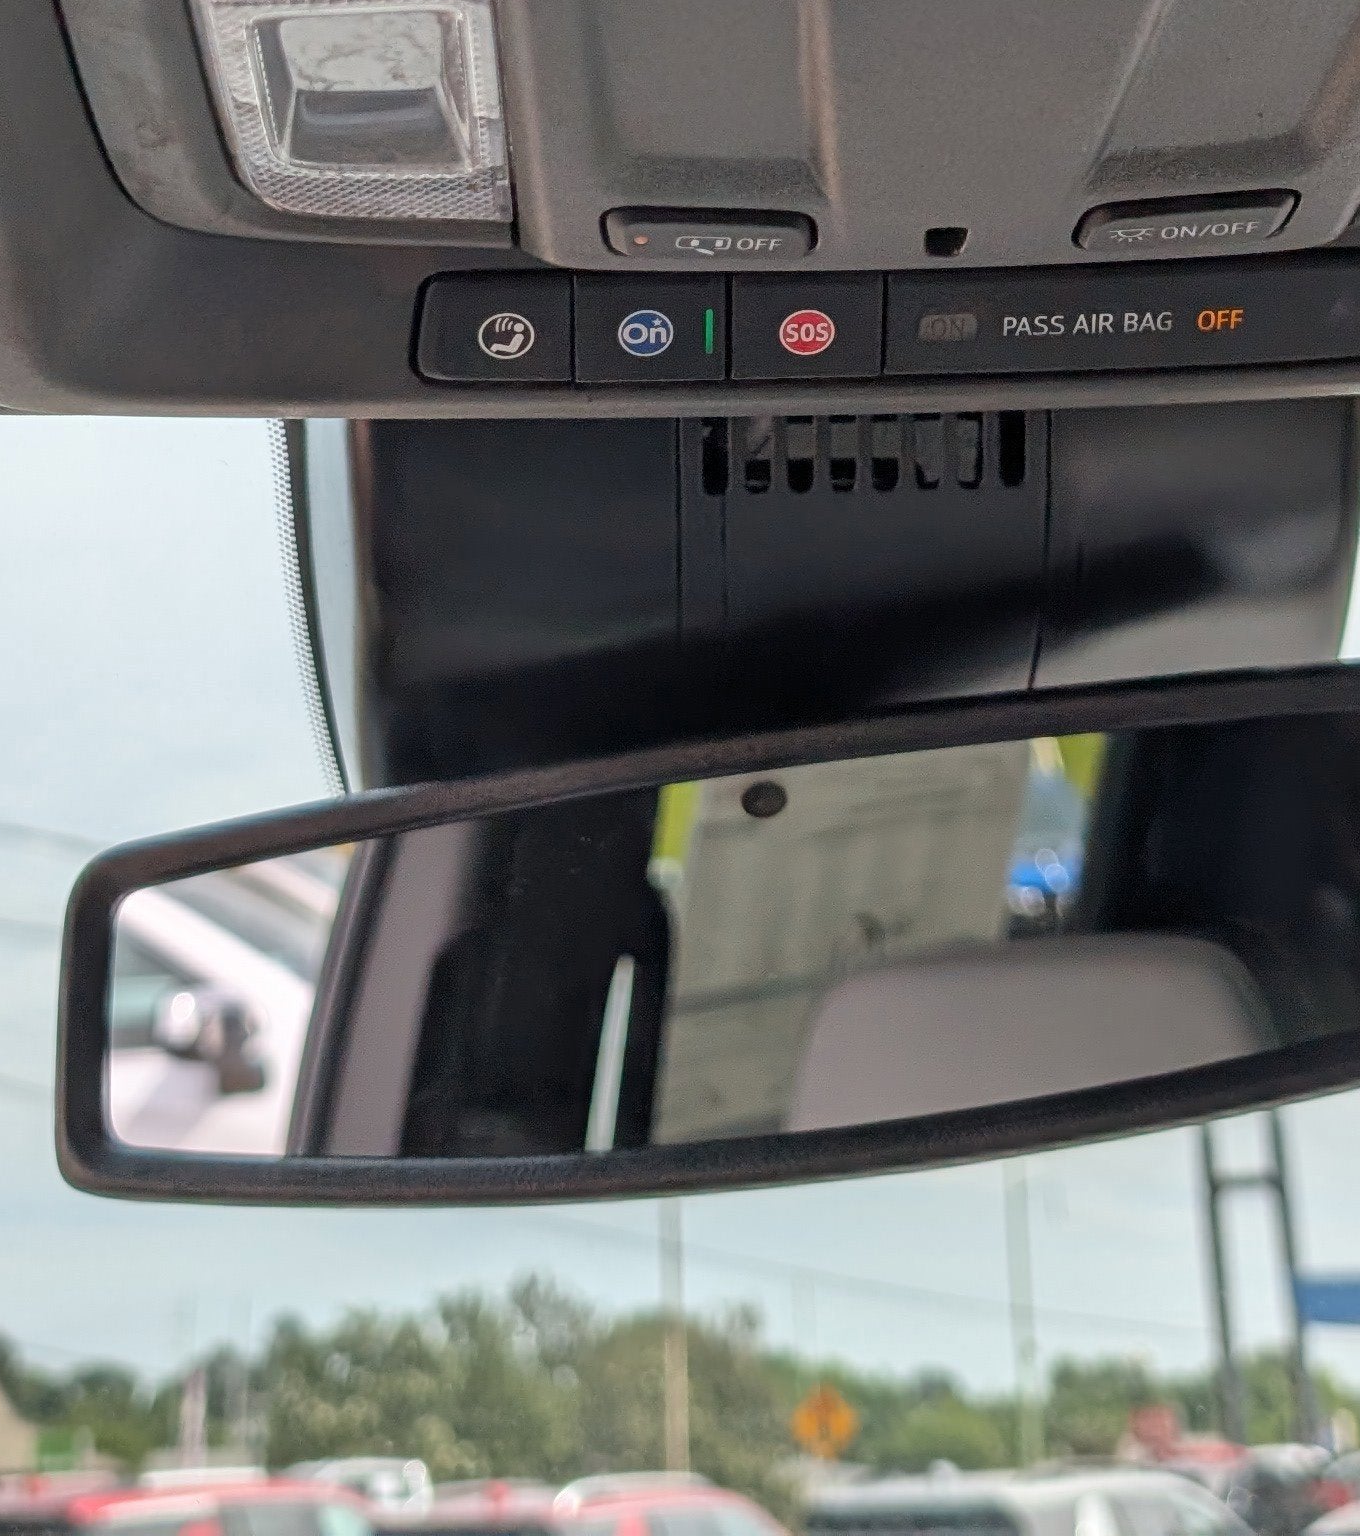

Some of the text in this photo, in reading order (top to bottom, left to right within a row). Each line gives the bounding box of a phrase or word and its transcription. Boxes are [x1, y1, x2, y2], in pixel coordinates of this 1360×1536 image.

[1160, 220, 1260, 240] ON/OFF
[736, 237, 783, 251] OFF
[1002, 315, 1065, 337] PASS
[1072, 313, 1114, 335] AIR
[1123, 311, 1173, 333] BAG
[1196, 308, 1245, 332] OFF
[785, 323, 830, 344] SOS
